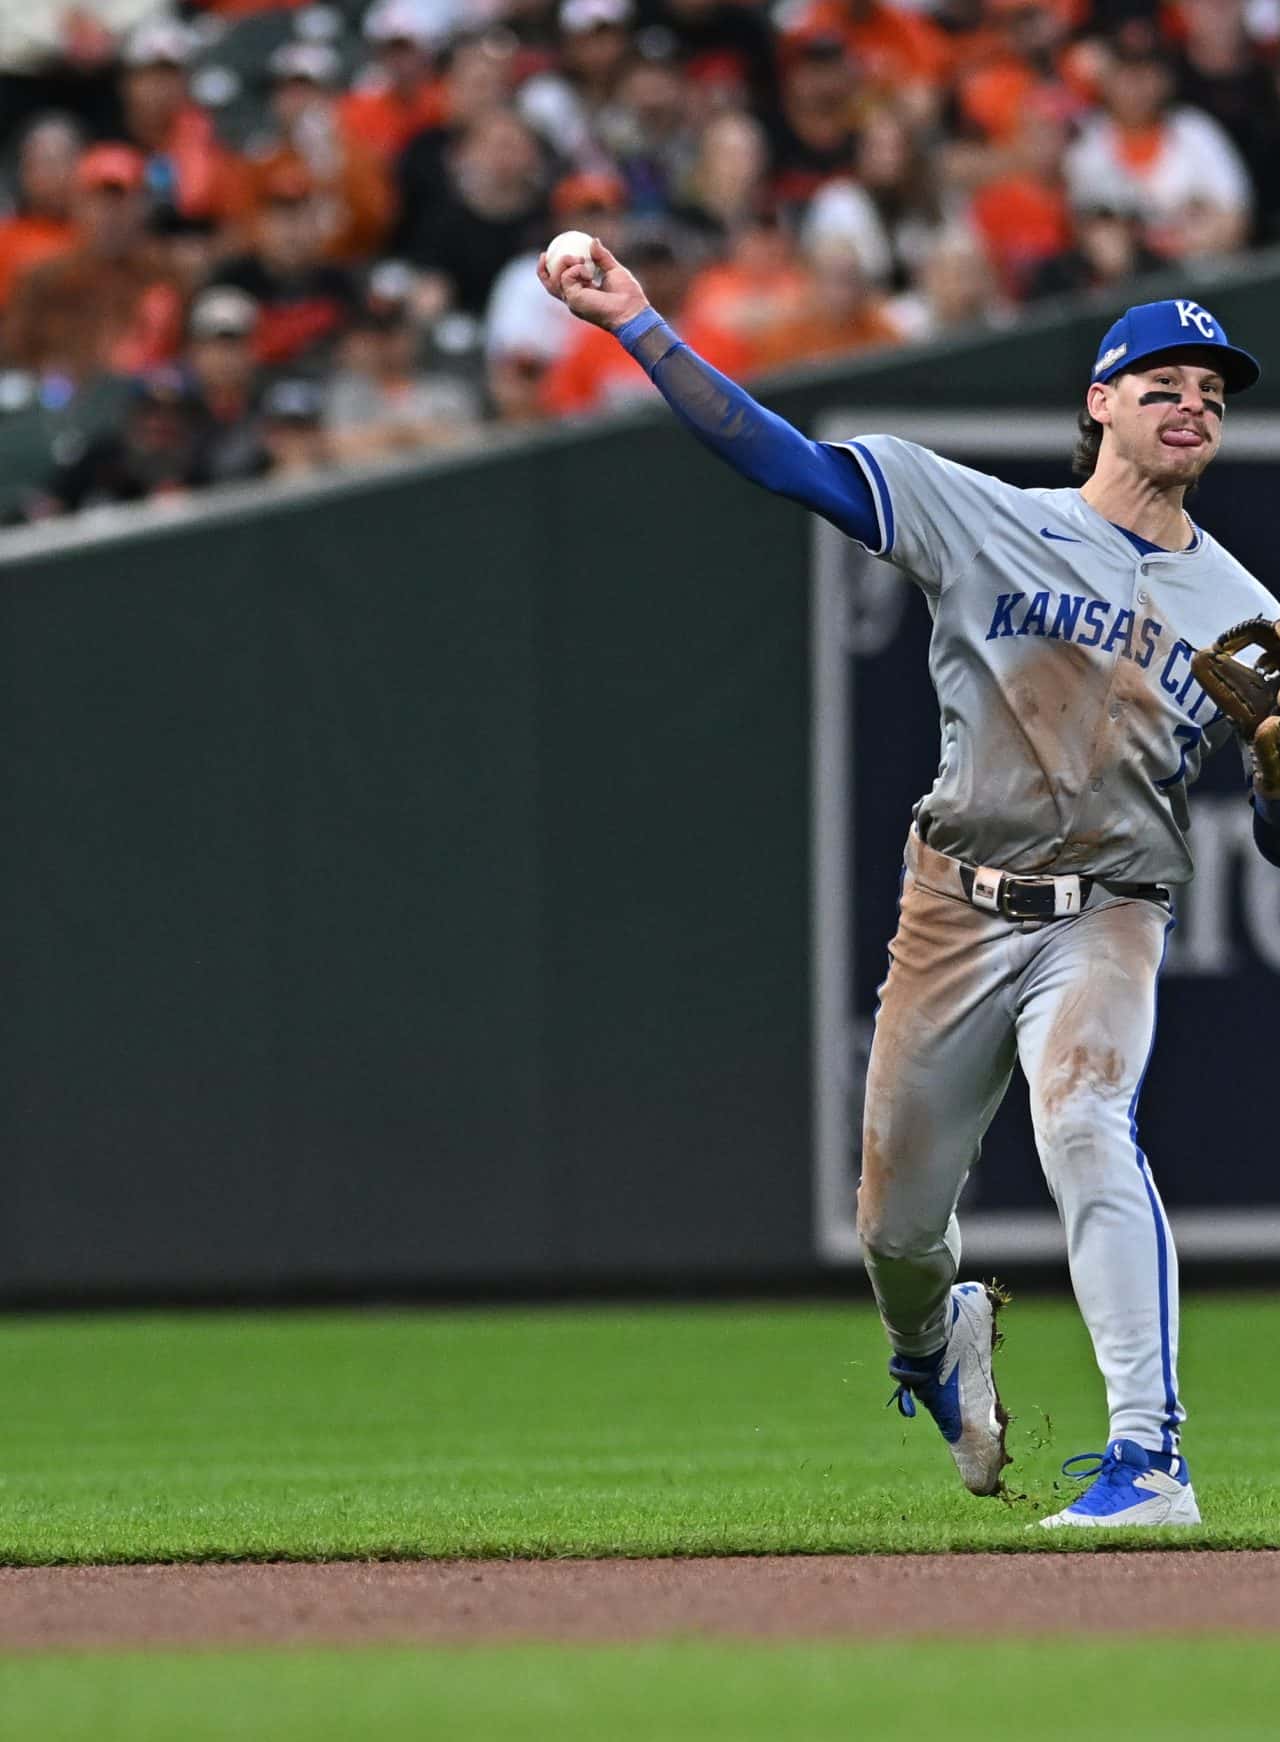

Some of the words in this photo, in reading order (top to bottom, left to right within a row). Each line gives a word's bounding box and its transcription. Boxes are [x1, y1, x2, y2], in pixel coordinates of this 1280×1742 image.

[1174, 301, 1214, 339] KC
[985, 591, 1162, 669] KANSAS
[1065, 891, 1074, 910] 7
